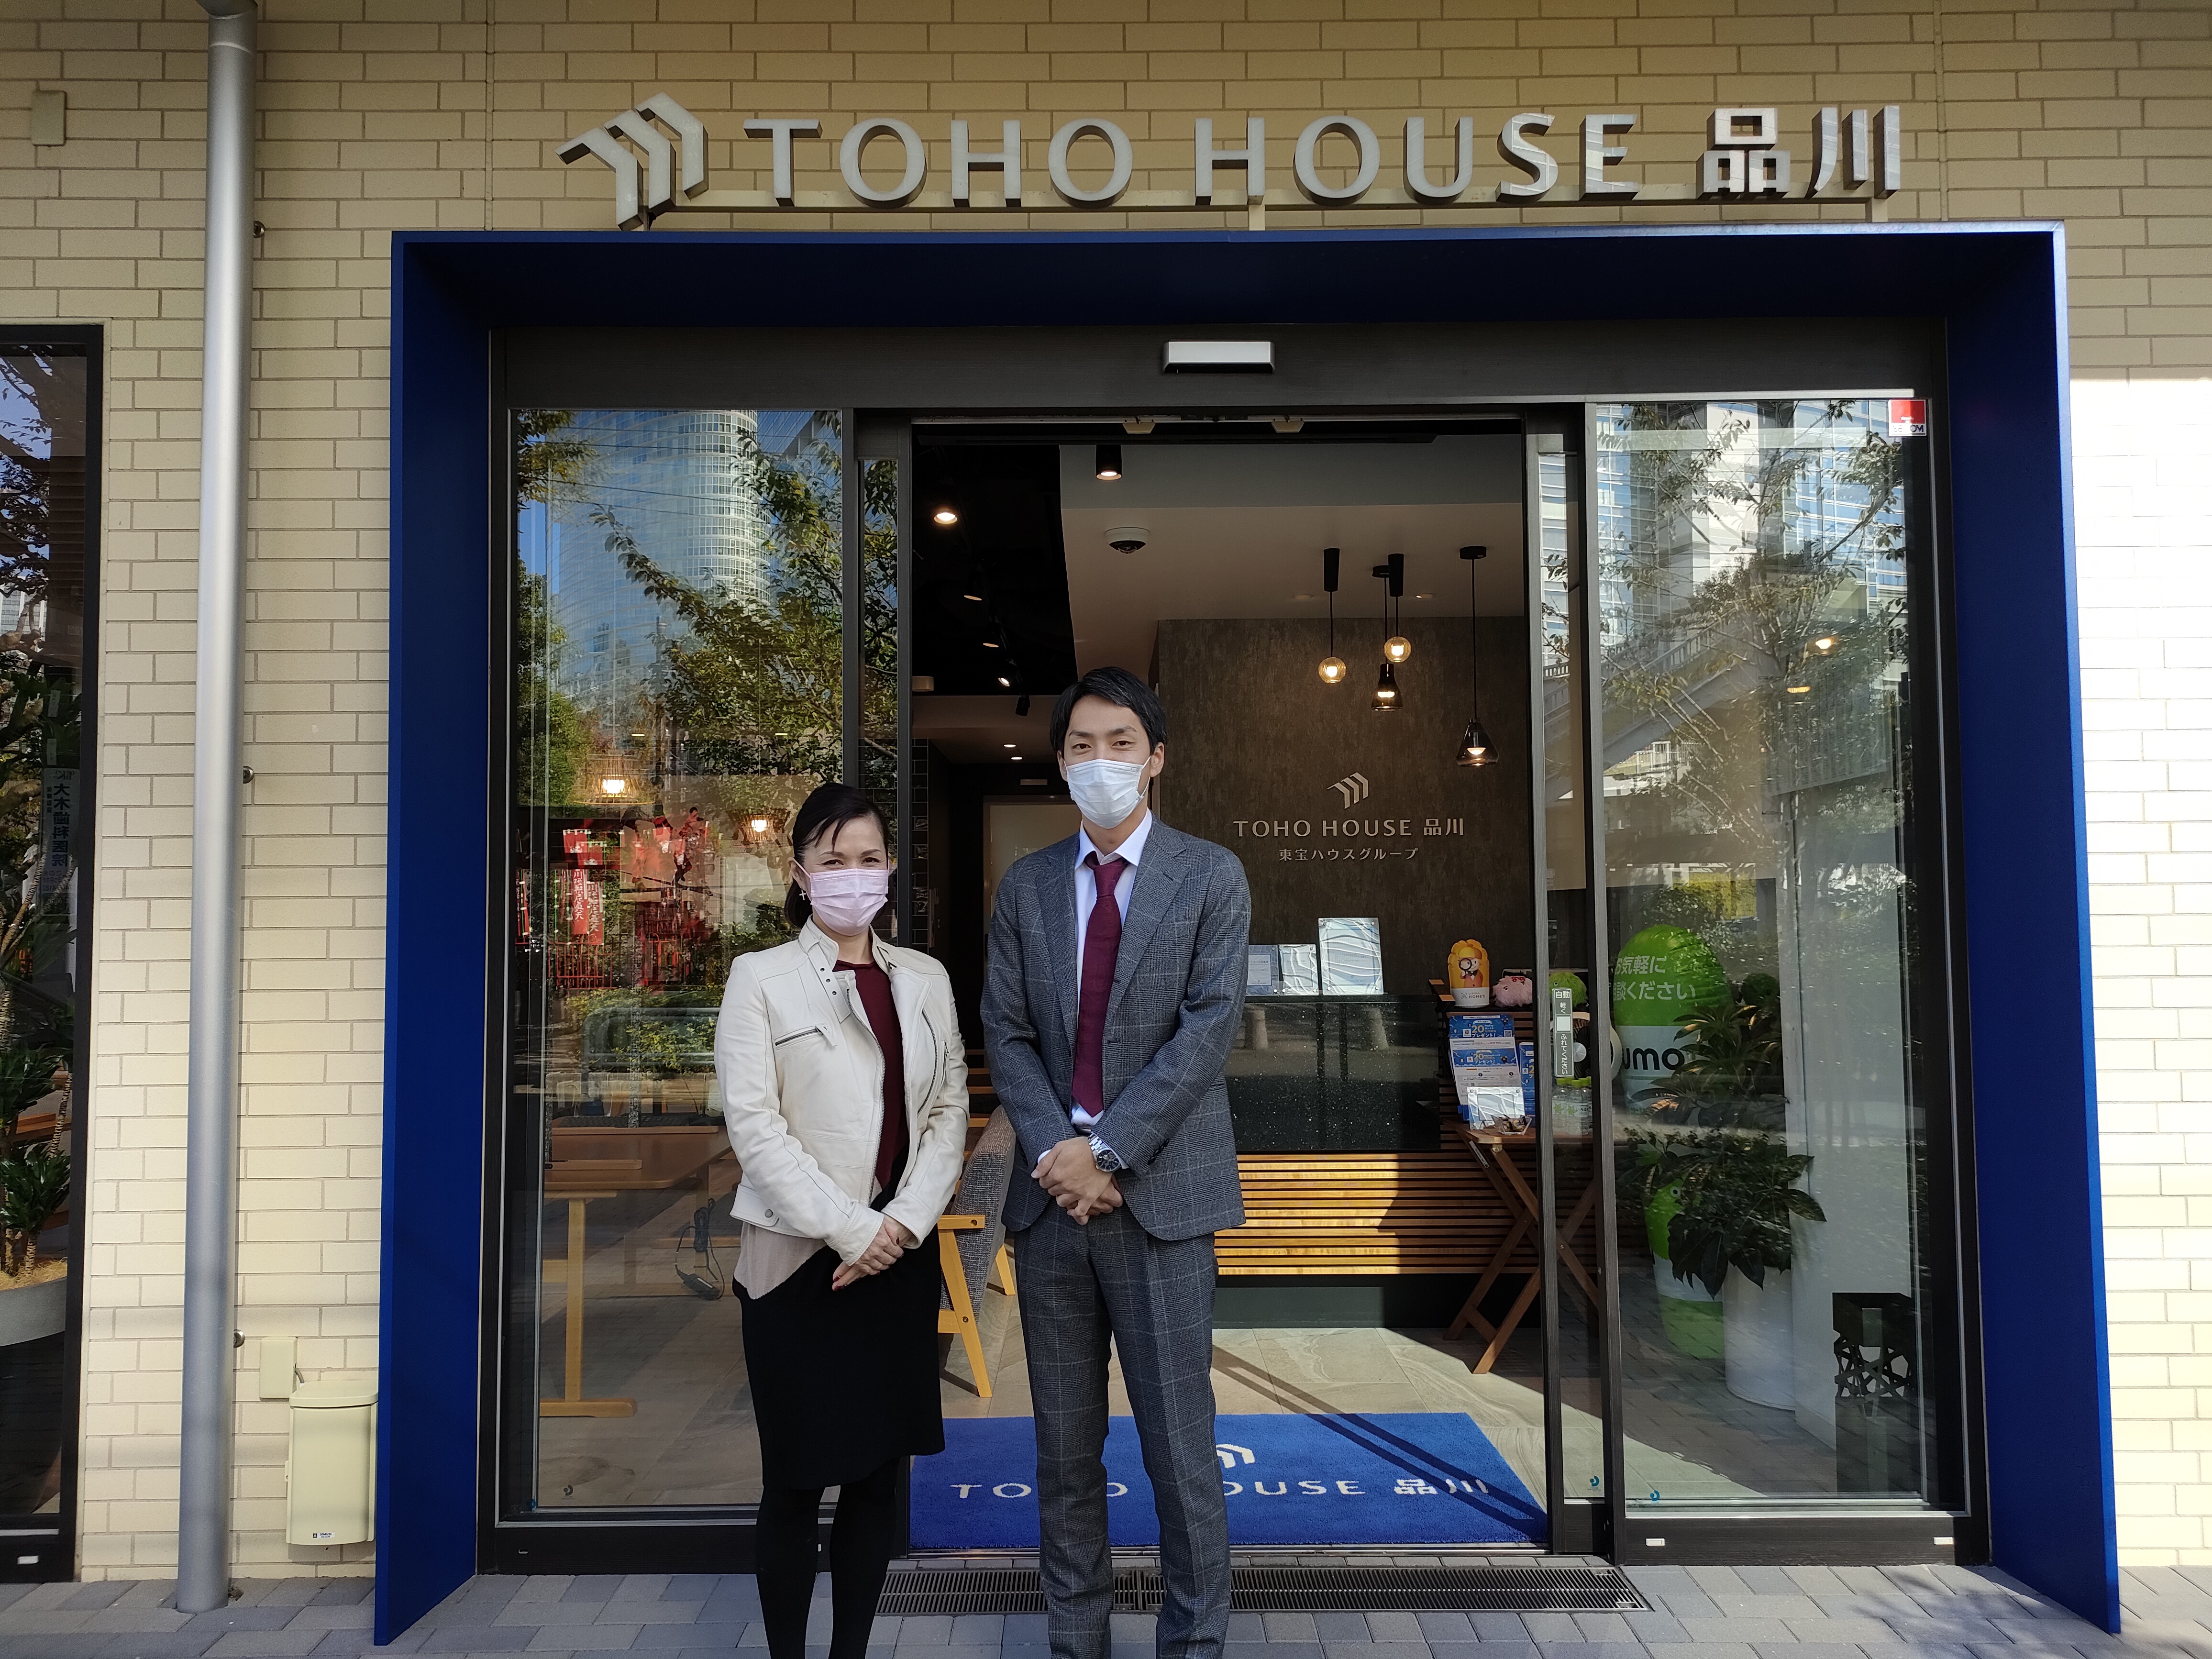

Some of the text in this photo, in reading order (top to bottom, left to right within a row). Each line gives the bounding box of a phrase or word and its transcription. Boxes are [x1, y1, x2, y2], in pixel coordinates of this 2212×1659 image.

[743, 105, 1900, 208] TOHO HOUSE 品川
[1893, 424, 1924, 432] SEOM
[1233, 818, 1464, 837] TOHO HOUSE 品川
[1279, 847, 1419, 862] 東宝ハウスグループ
[1613, 981, 1696, 1001] 談ください
[1559, 1002, 1566, 1014] 軽く
[1471, 1025, 1484, 1033] 20
[950, 1478, 1489, 1499] TOO OUSE 品川
